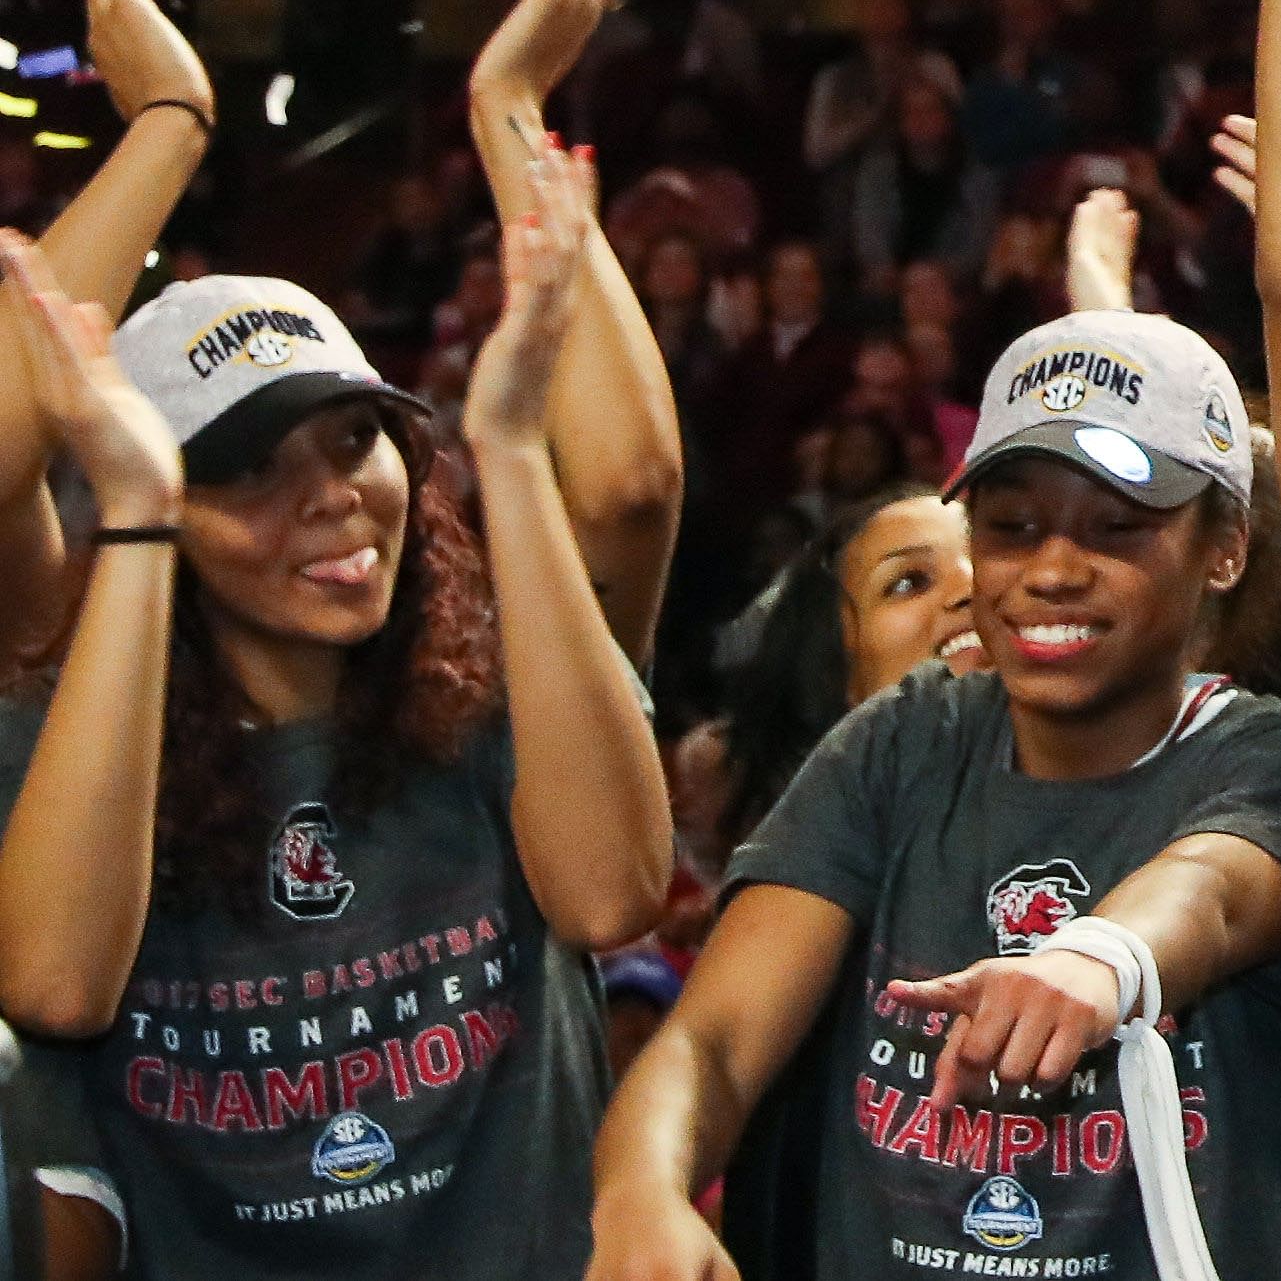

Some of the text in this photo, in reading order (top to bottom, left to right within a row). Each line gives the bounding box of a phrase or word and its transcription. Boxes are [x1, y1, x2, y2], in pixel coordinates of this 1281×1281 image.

[188, 308, 325, 379] CHAMPIONS
[1007, 351, 1143, 405] CHAMPIONS
[1041, 374, 1086, 411] SEC
[130, 947, 516, 1057] TOURNAMEN
[208, 976, 288, 1012] SEC
[262, 1197, 318, 1222] JUST
[323, 1179, 406, 1215] MEANS
[906, 1244, 959, 1271] JUST
[963, 1250, 1041, 1278] MEANS
